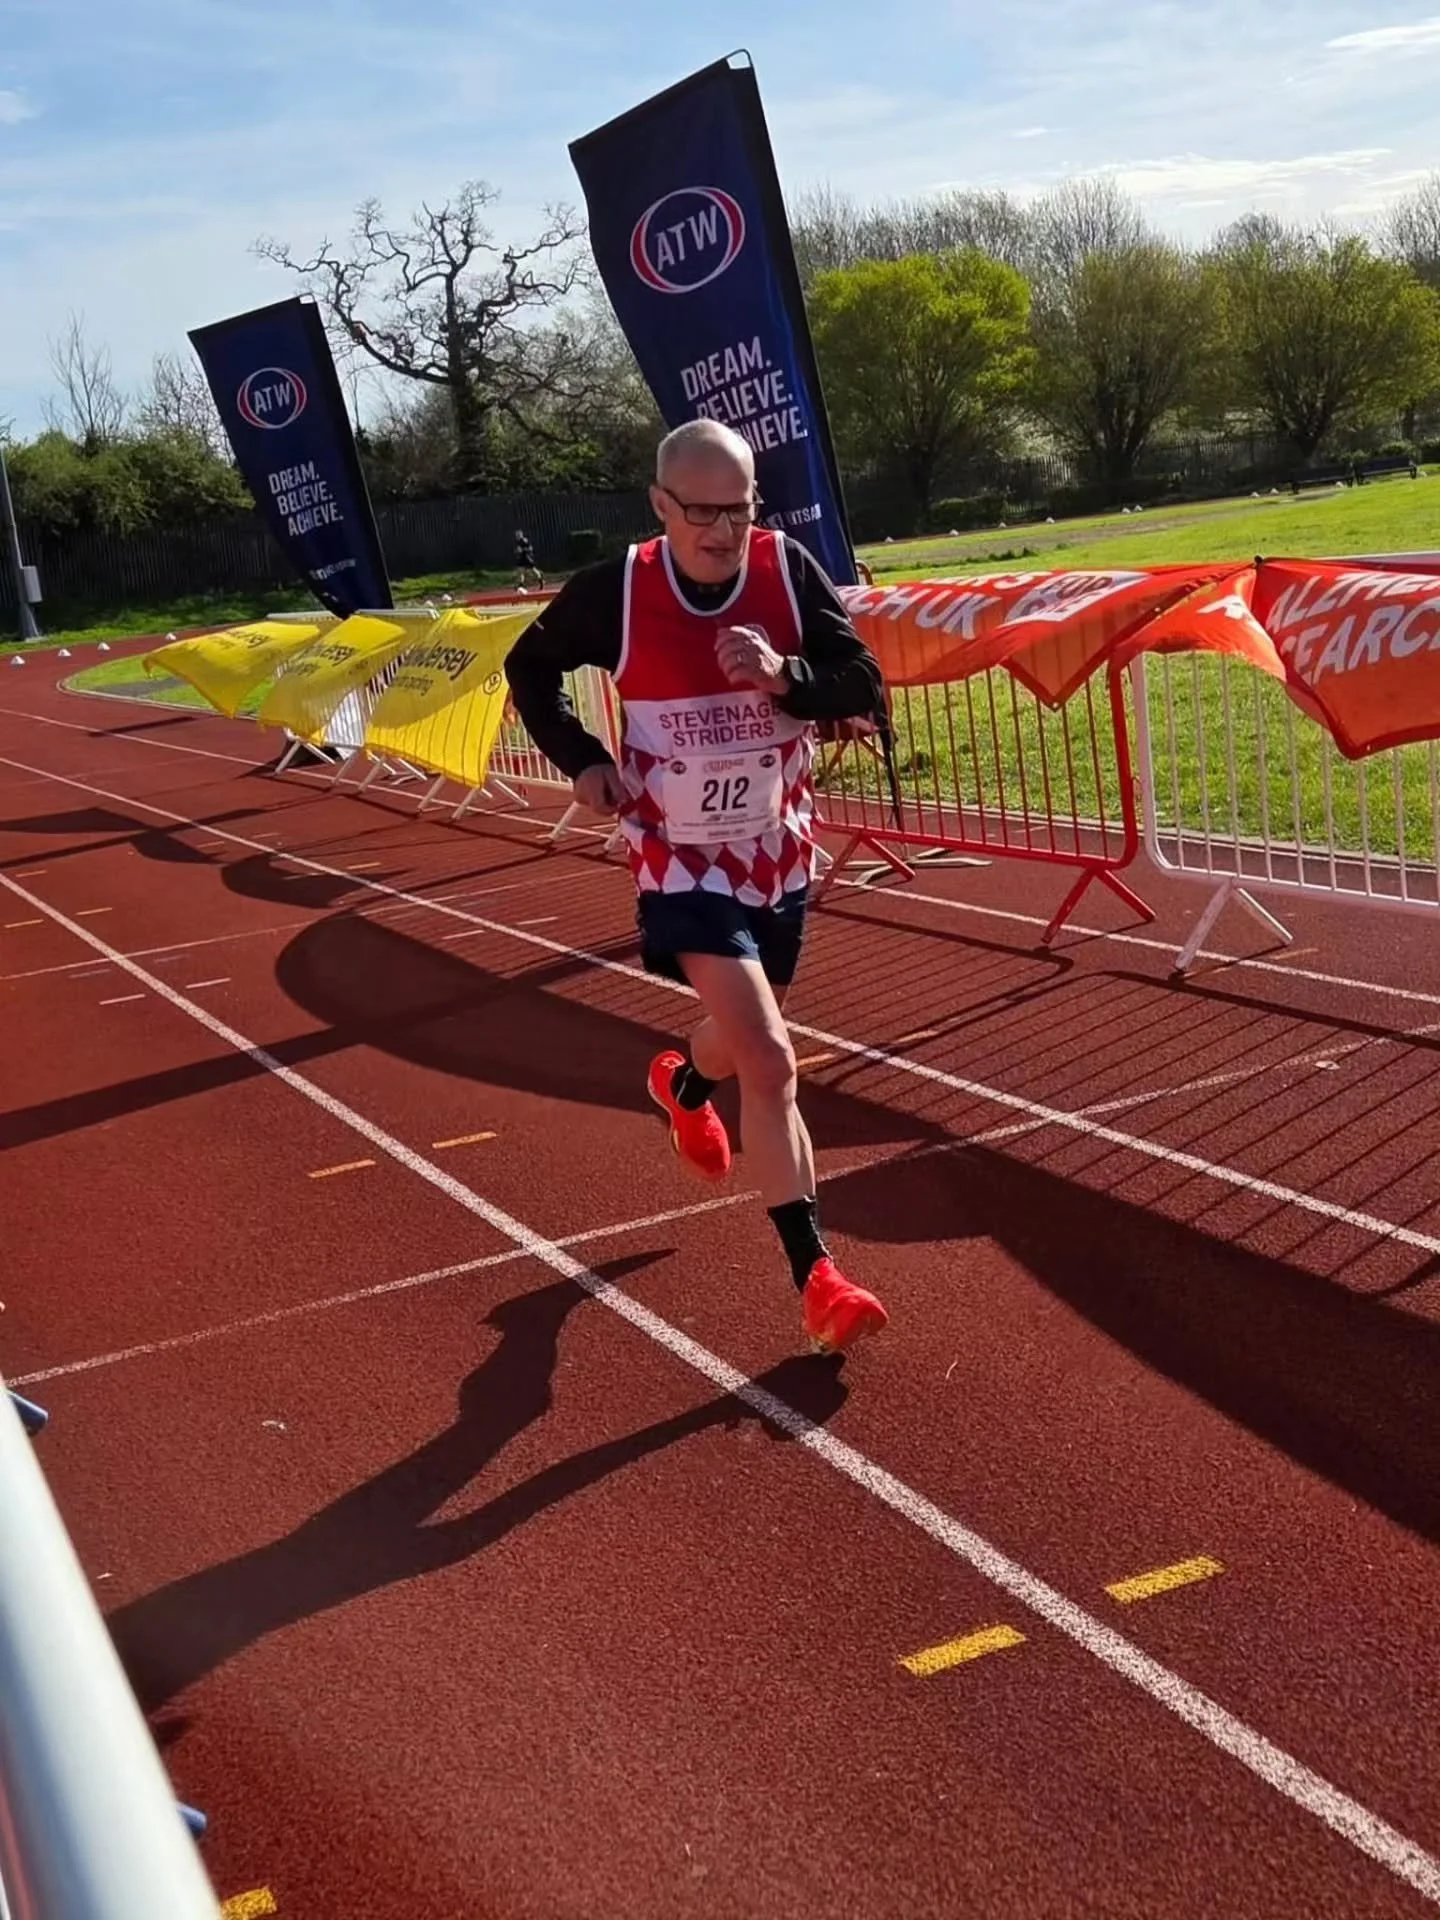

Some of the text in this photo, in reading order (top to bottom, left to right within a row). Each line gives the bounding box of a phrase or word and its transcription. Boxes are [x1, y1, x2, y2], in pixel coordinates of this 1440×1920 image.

[655, 205, 719, 273] ATW
[680, 335, 772, 401] DREAM.
[253, 381, 291, 415] ATW
[268, 460, 320, 495] DREAM.
[276, 480, 333, 516] BELIEVE.
[287, 502, 344, 537] ACHIEVE.
[673, 720, 775, 747] STRIDERS
[701, 776, 750, 812] 212
